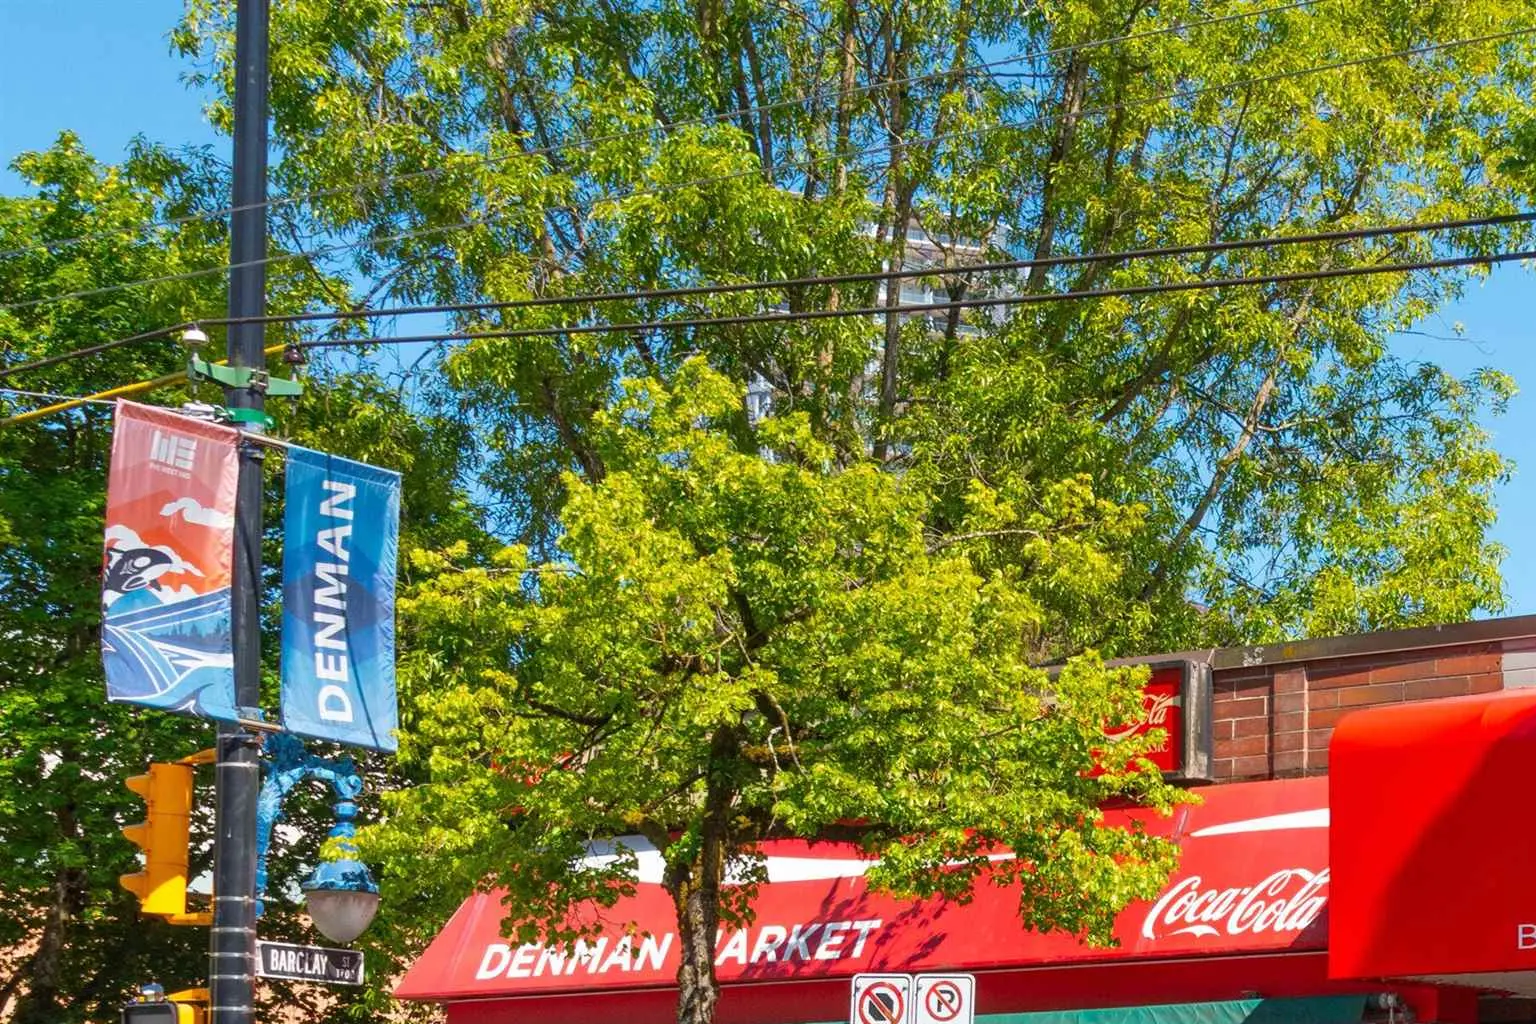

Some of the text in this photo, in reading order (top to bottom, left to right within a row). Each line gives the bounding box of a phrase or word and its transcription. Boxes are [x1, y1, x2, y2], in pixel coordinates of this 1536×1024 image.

[313, 480, 357, 723] DENMAN
[1142, 868, 1330, 940] Coca-Cola
[270, 948, 328, 976] BARCLAY
[475, 919, 882, 981] DENMAN ARKET
